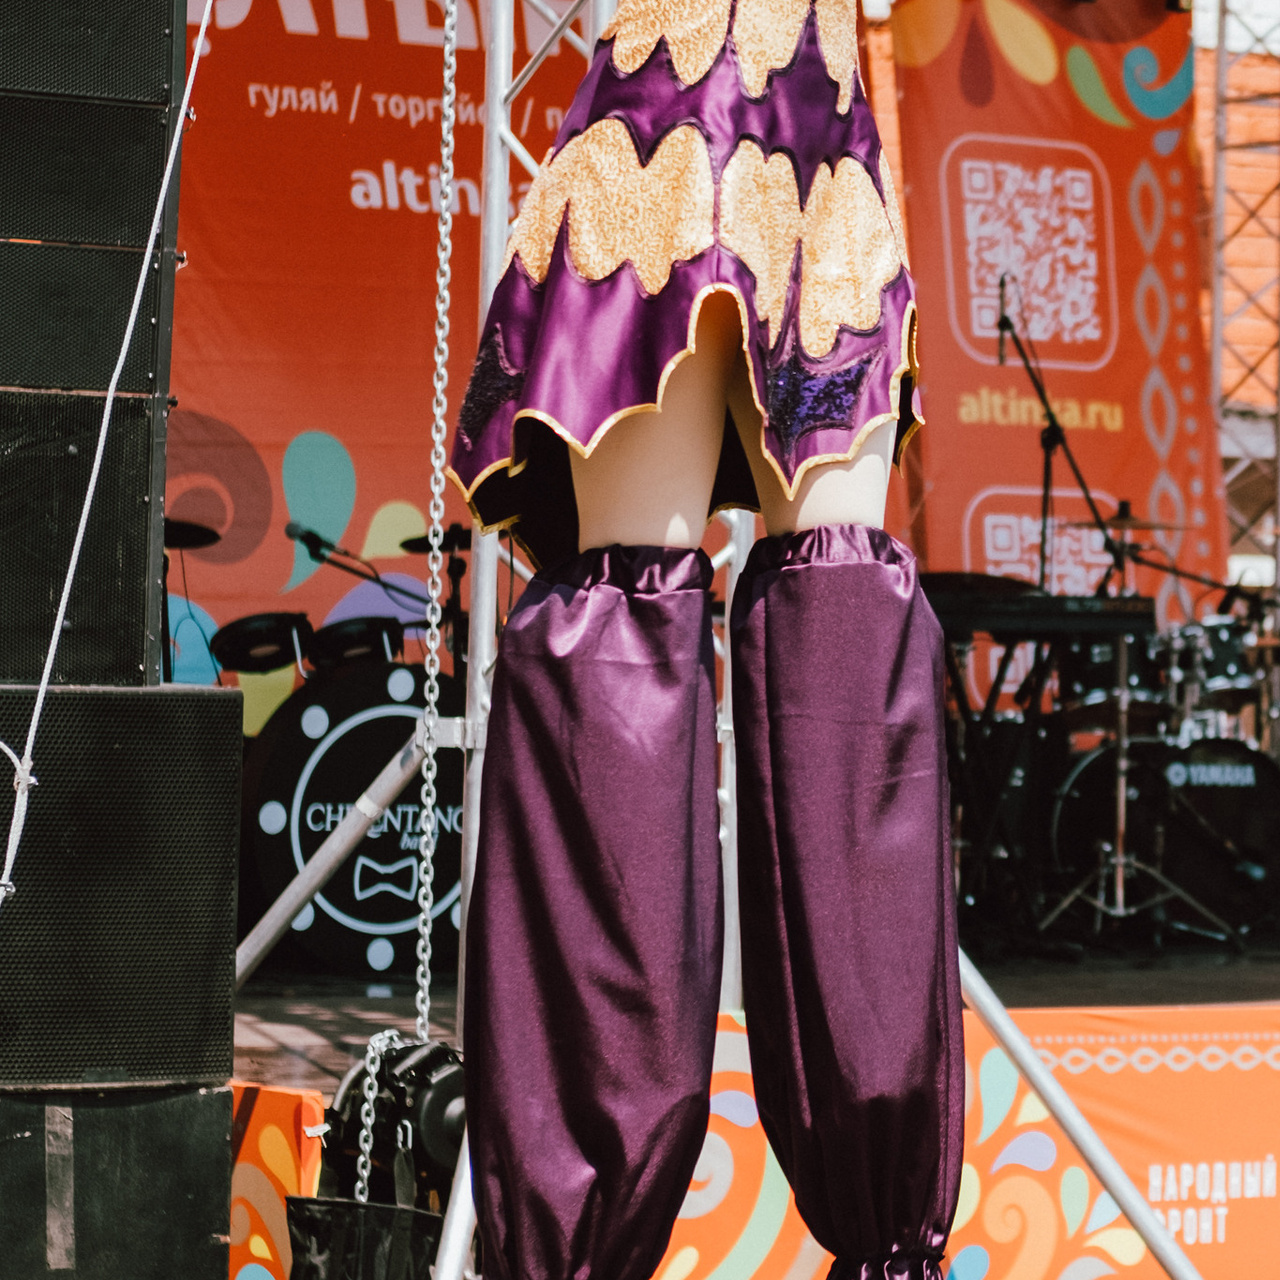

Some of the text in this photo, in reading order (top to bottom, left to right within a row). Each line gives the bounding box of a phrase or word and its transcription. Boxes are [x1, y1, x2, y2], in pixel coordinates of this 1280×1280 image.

[248, 82, 339, 118] гуляй
[1189, 763, 1256, 787] YAMAHA
[1149, 1154, 1277, 1204] НАРОДНЫЙ
